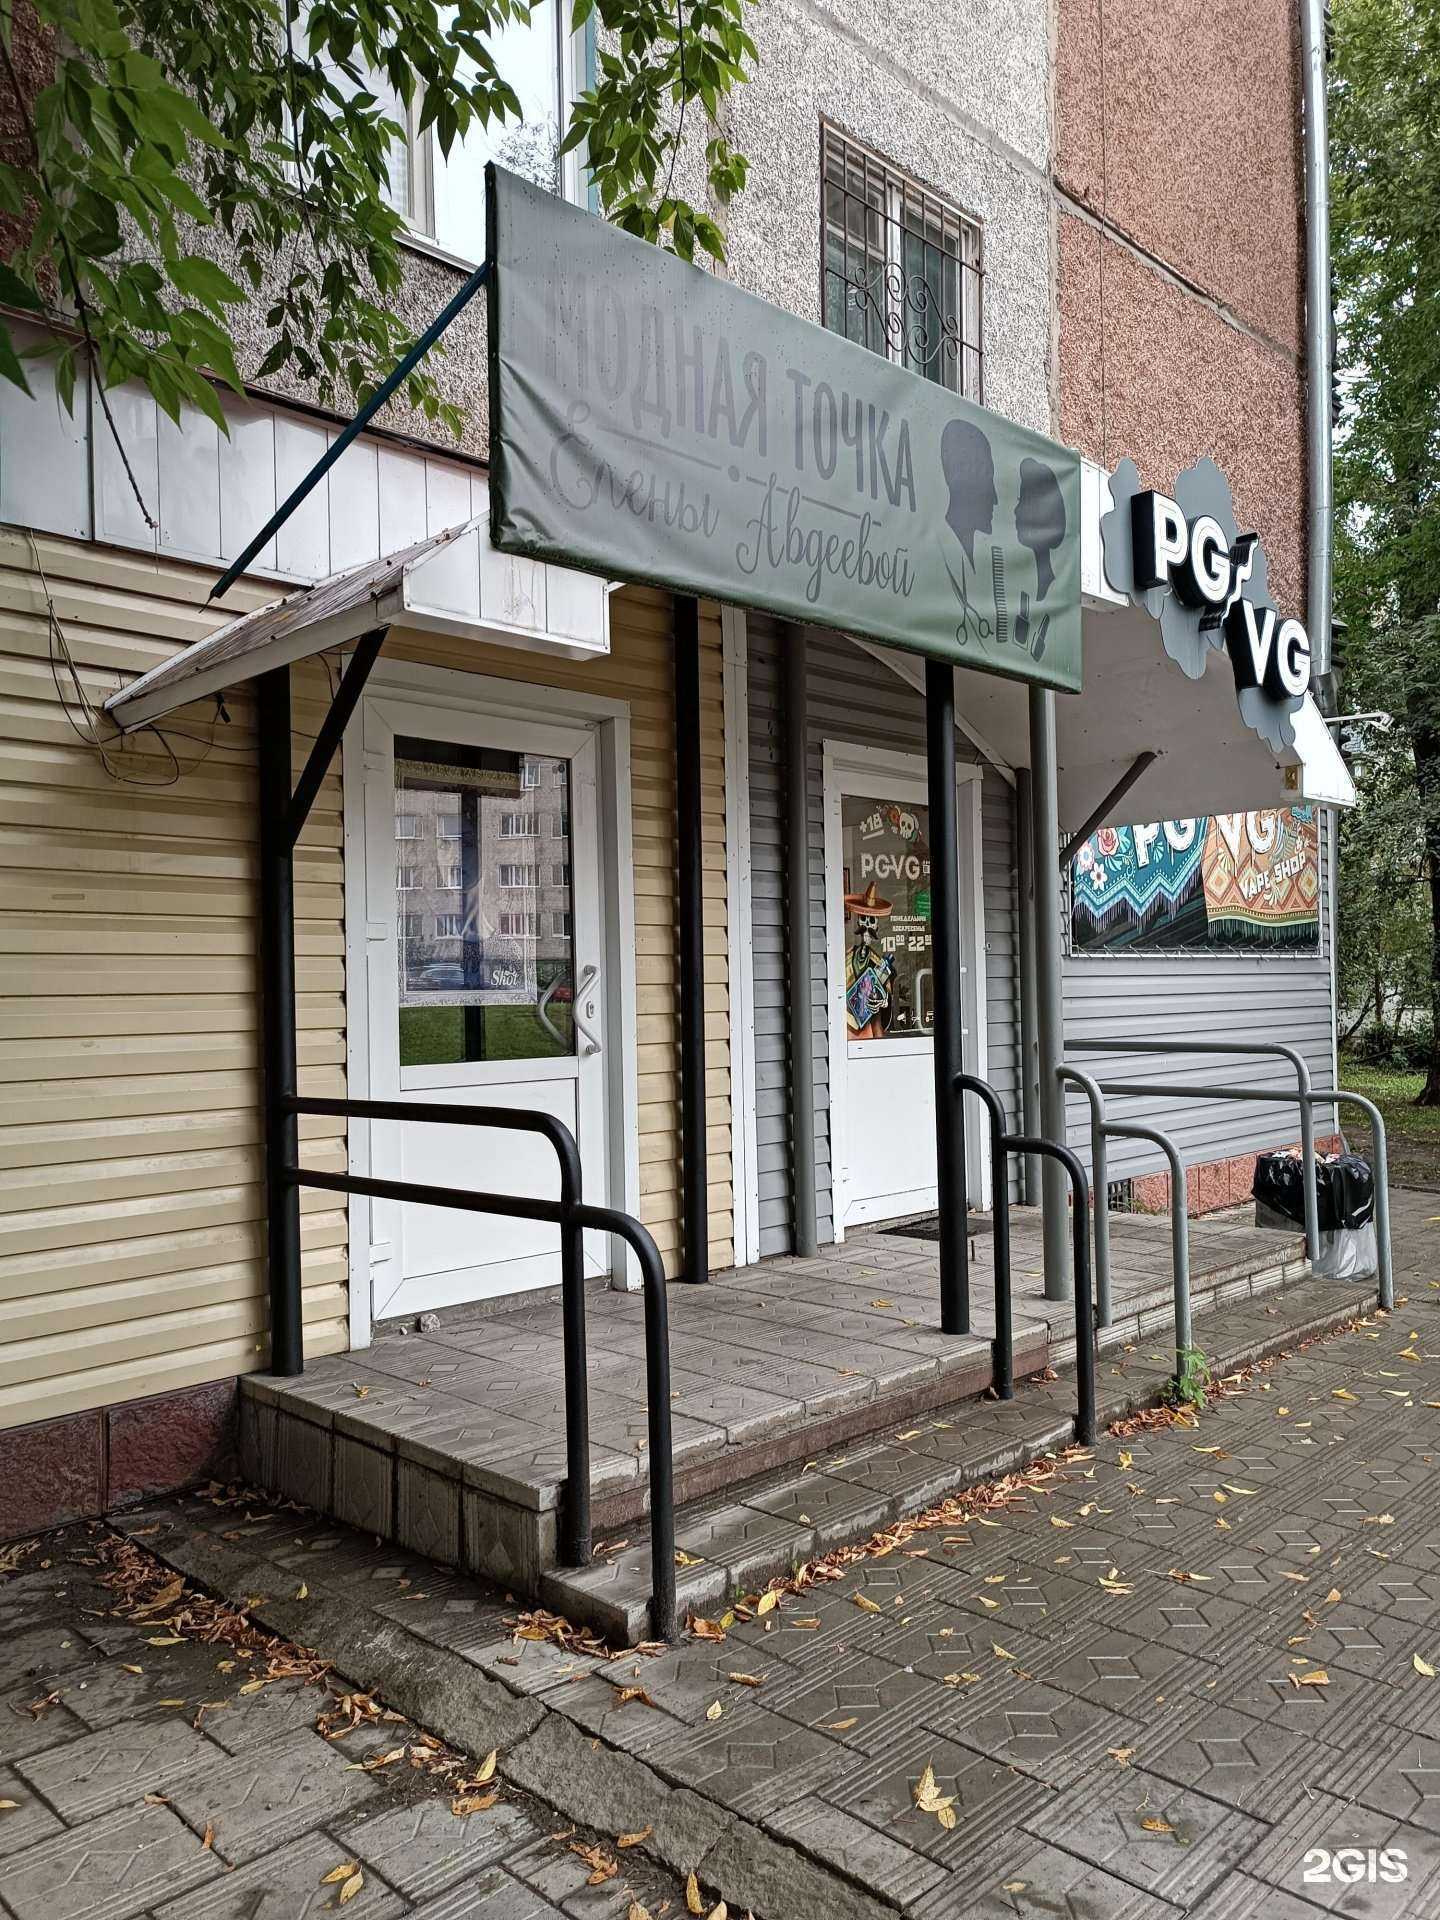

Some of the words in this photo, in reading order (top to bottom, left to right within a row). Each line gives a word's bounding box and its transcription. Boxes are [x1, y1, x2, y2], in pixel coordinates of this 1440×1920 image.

[786, 368, 917, 513] ТОЧКА
[549, 401, 721, 539] Елены
[735, 471, 916, 603] Авдеевой
[1241, 599, 1312, 697] VG
[1240, 874, 1271, 901] VAPE
[1273, 851, 1307, 885] SHOP
